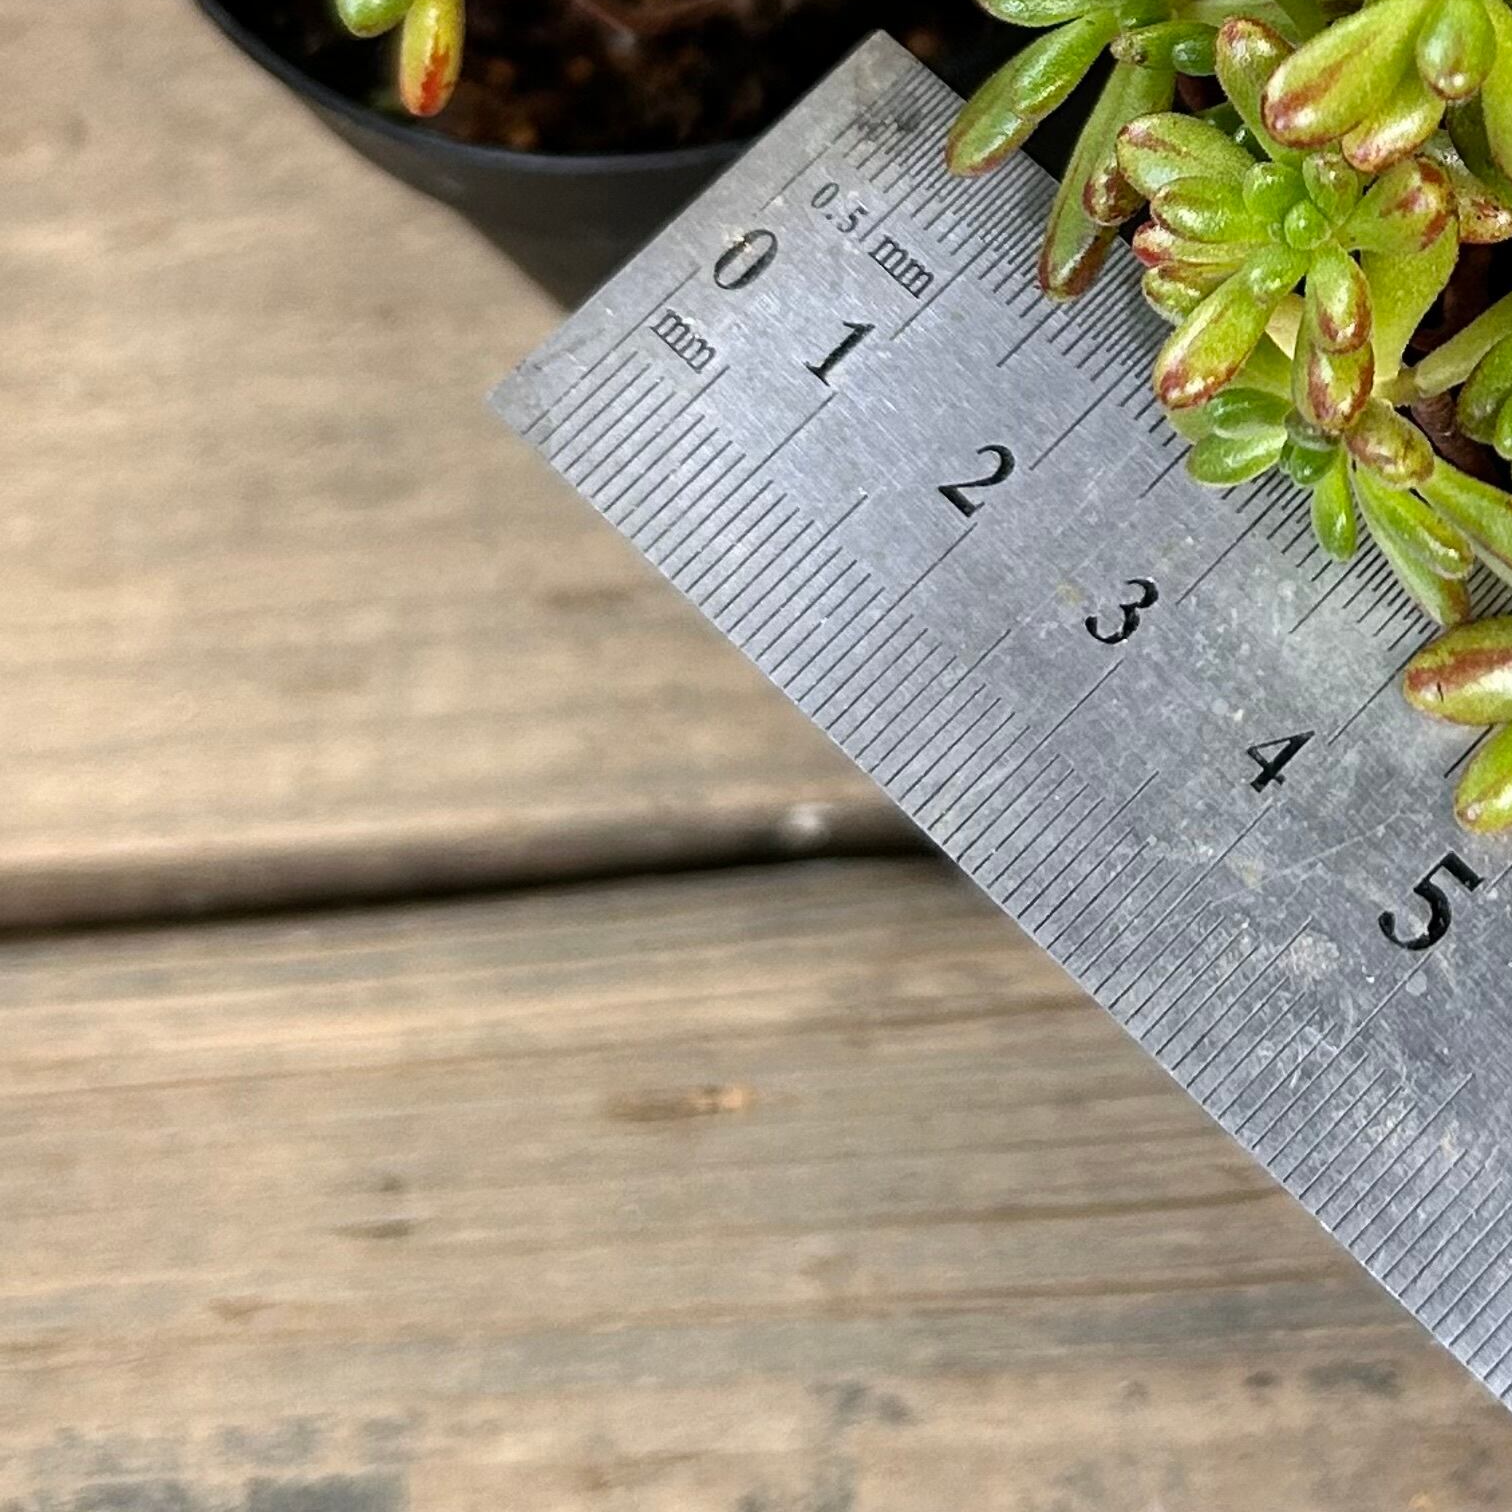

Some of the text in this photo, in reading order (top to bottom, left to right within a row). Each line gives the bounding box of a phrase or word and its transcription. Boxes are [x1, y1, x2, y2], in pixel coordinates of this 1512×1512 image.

[810, 182, 935, 300] 0.5 mm
[650, 307, 717, 374] mm
[713, 228, 778, 290] 0
[803, 320, 876, 387] 1
[937, 444, 1016, 518] 2
[1084, 577, 1159, 645] 3
[1246, 729, 1316, 794] 4
[1377, 849, 1486, 952] 5
